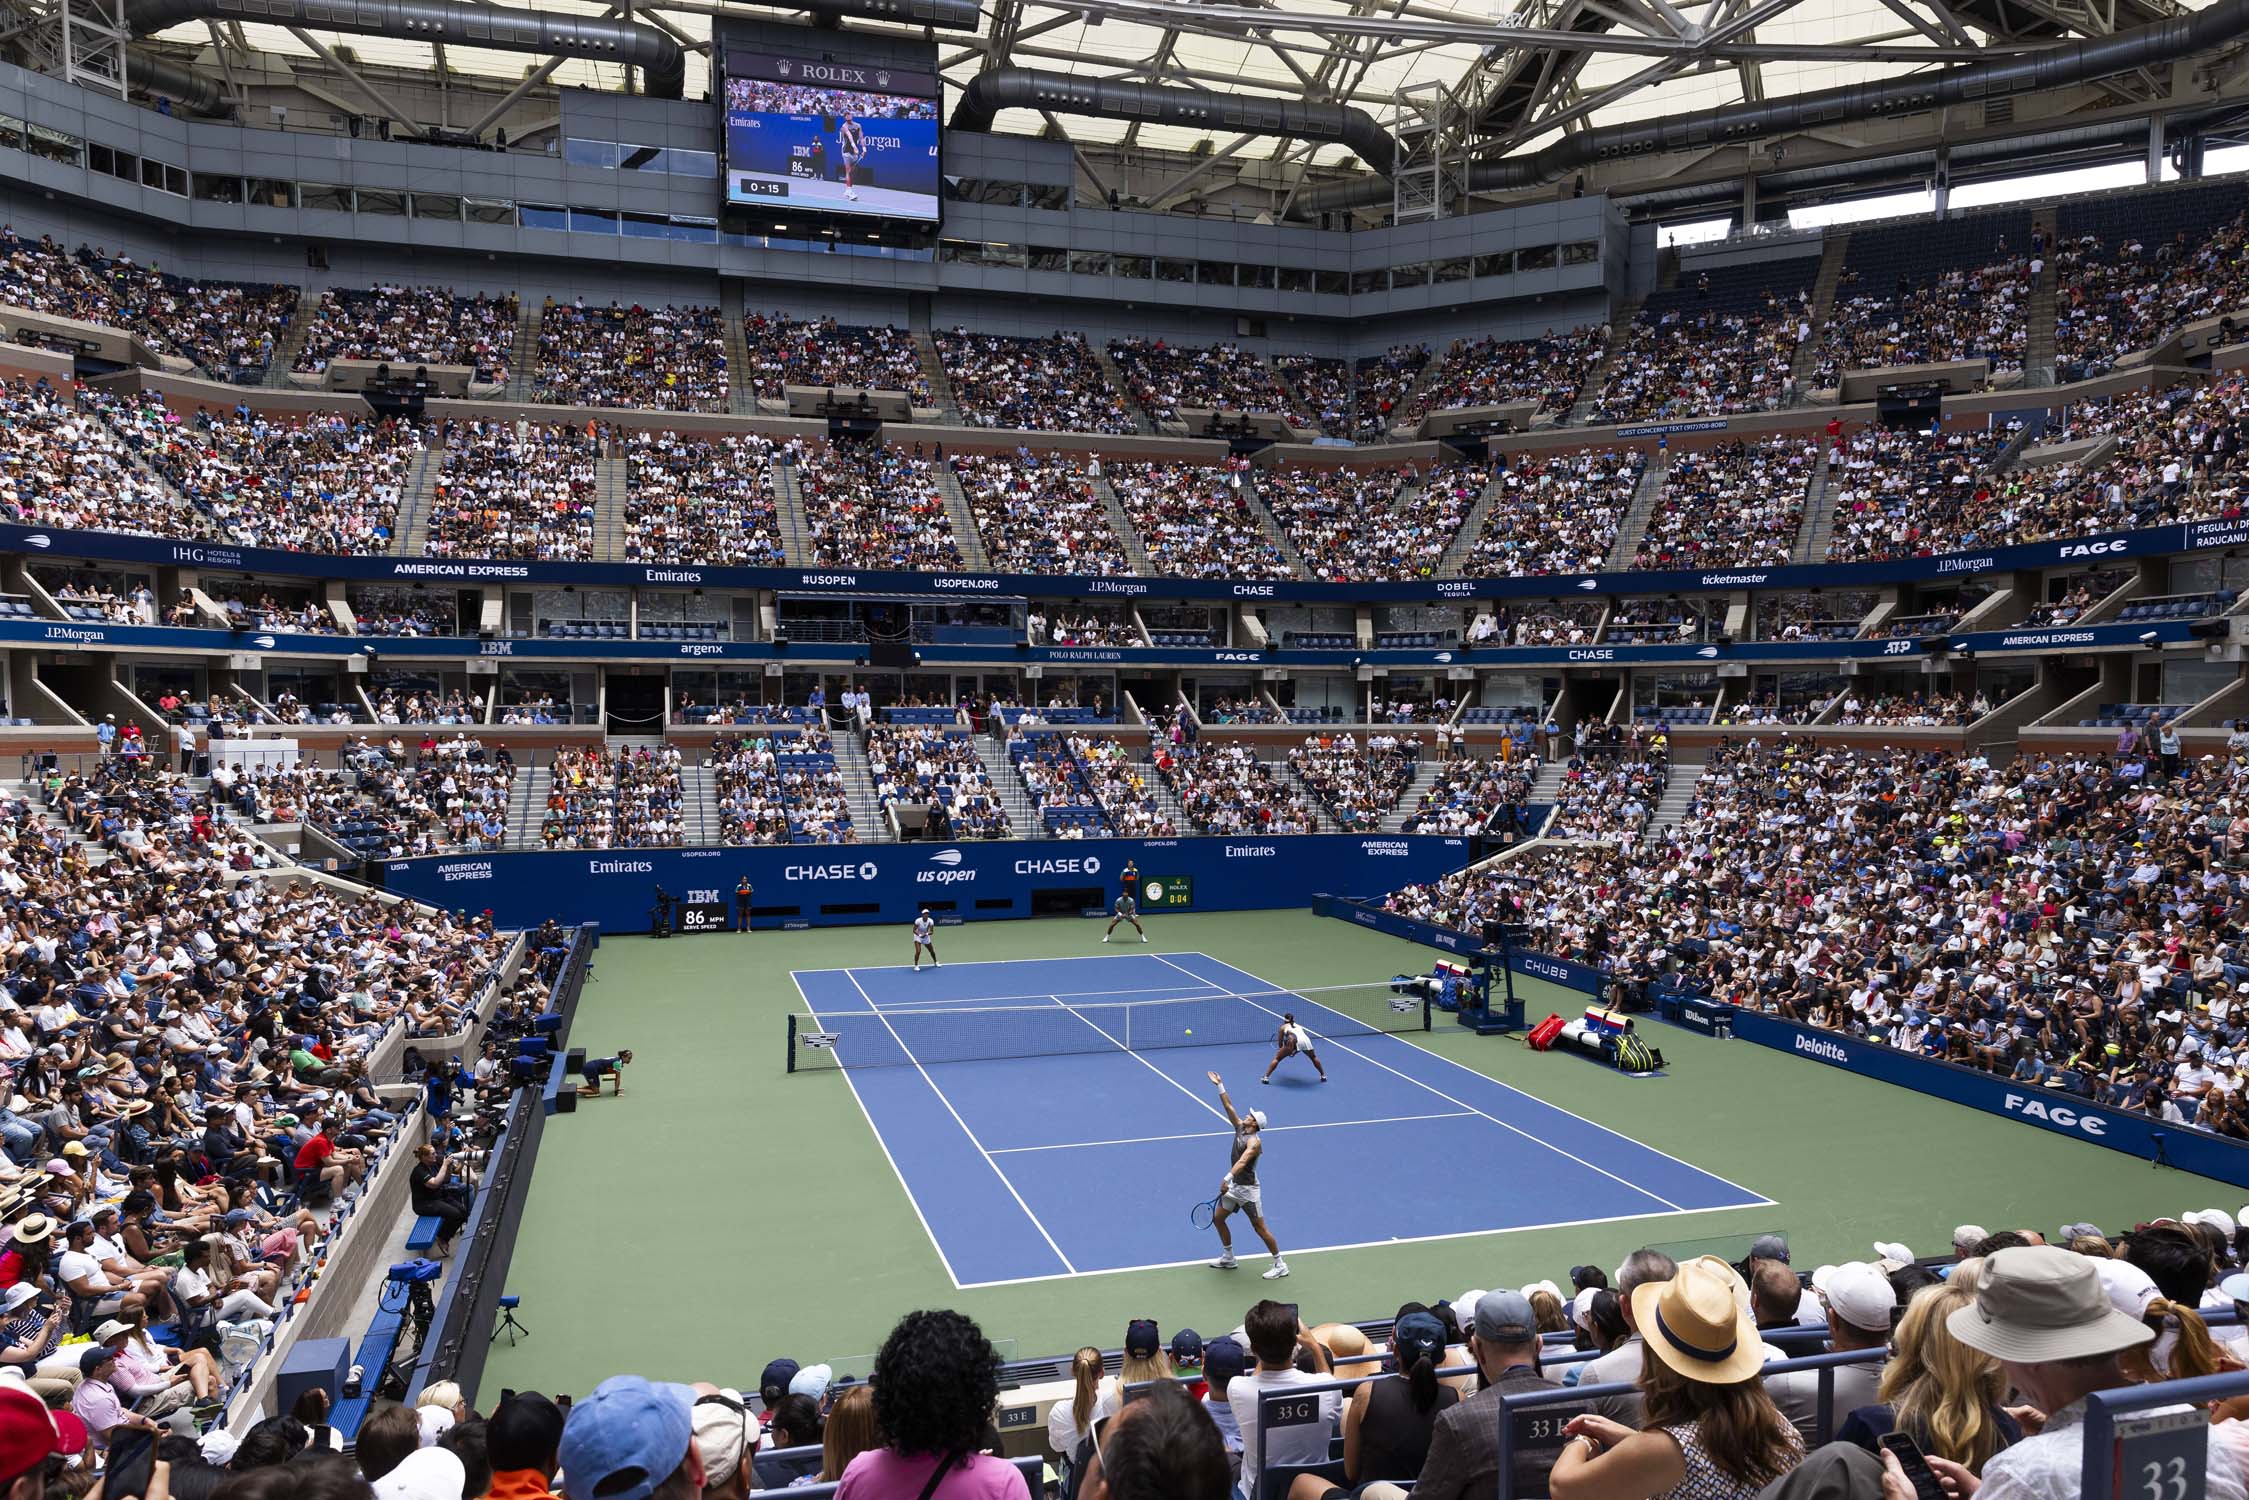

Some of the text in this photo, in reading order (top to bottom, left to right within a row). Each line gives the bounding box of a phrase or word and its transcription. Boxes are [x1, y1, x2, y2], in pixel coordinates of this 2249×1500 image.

[802, 64, 866, 84] ROLEX
[730, 116, 761, 128] Emirates
[793, 145, 810, 157] IBM
[792, 161, 803, 172] 86
[750, 182, 758, 191] 0
[768, 184, 779, 193] 15
[1637, 426, 1667, 435] CONCERN?
[1669, 424, 1683, 432] TEXT
[2197, 521, 2232, 534] PEGULA
[2197, 532, 2247, 547] RADUCANU
[173, 546, 204, 562] IHG
[207, 550, 234, 558] HOTELS
[207, 557, 241, 565] RESORTS
[1936, 556, 1993, 573] J.P.Morgan
[394, 564, 529, 577] AMERICAN EXPRESS
[646, 569, 701, 583] Emirates
[802, 575, 856, 586] #USOPEN
[934, 578, 999, 589] USOPEN.ORG
[1702, 573, 1767, 585] ticketmaster
[1088, 582, 1147, 596] J.P.Morgan
[1233, 585, 1274, 596] CHASE
[1437, 582, 1476, 592] DOBEL
[45, 627, 104, 643] J.P.Morgan
[2003, 632, 2095, 646] AMERICAN EXPRESS
[480, 641, 512, 655] IBM
[681, 644, 723, 656] argenx
[1884, 641, 1911, 654] ATP
[1050, 651, 1121, 660] POLO RALPH LAUREN
[1569, 649, 1614, 660] CHASE
[1225, 845, 1276, 857] Emirates
[1361, 840, 1409, 849] AMERICAN
[1367, 848, 1409, 856] EXPRESS
[390, 863, 409, 871] USTA
[437, 862, 492, 873] AMERICAN
[589, 860, 652, 874] Emirates
[785, 864, 856, 880] CHASE
[1015, 859, 1080, 874] CHASE
[445, 870, 493, 881] EXPRESS
[916, 869, 976, 885] us open
[687, 889, 719, 904] IBM
[1169, 894, 1187, 903] 0:04
[685, 910, 705, 924] 86
[1524, 958, 1569, 980] CHUBB
[1684, 1009, 1709, 1026] Wilson
[1795, 1033, 1848, 1064] Deloitte.
[1007, 1411, 1028, 1423] 33 E
[1277, 1403, 1309, 1420] 33 G
[1529, 1420, 1550, 1439] 33
[2143, 1456, 2187, 1500] 33
